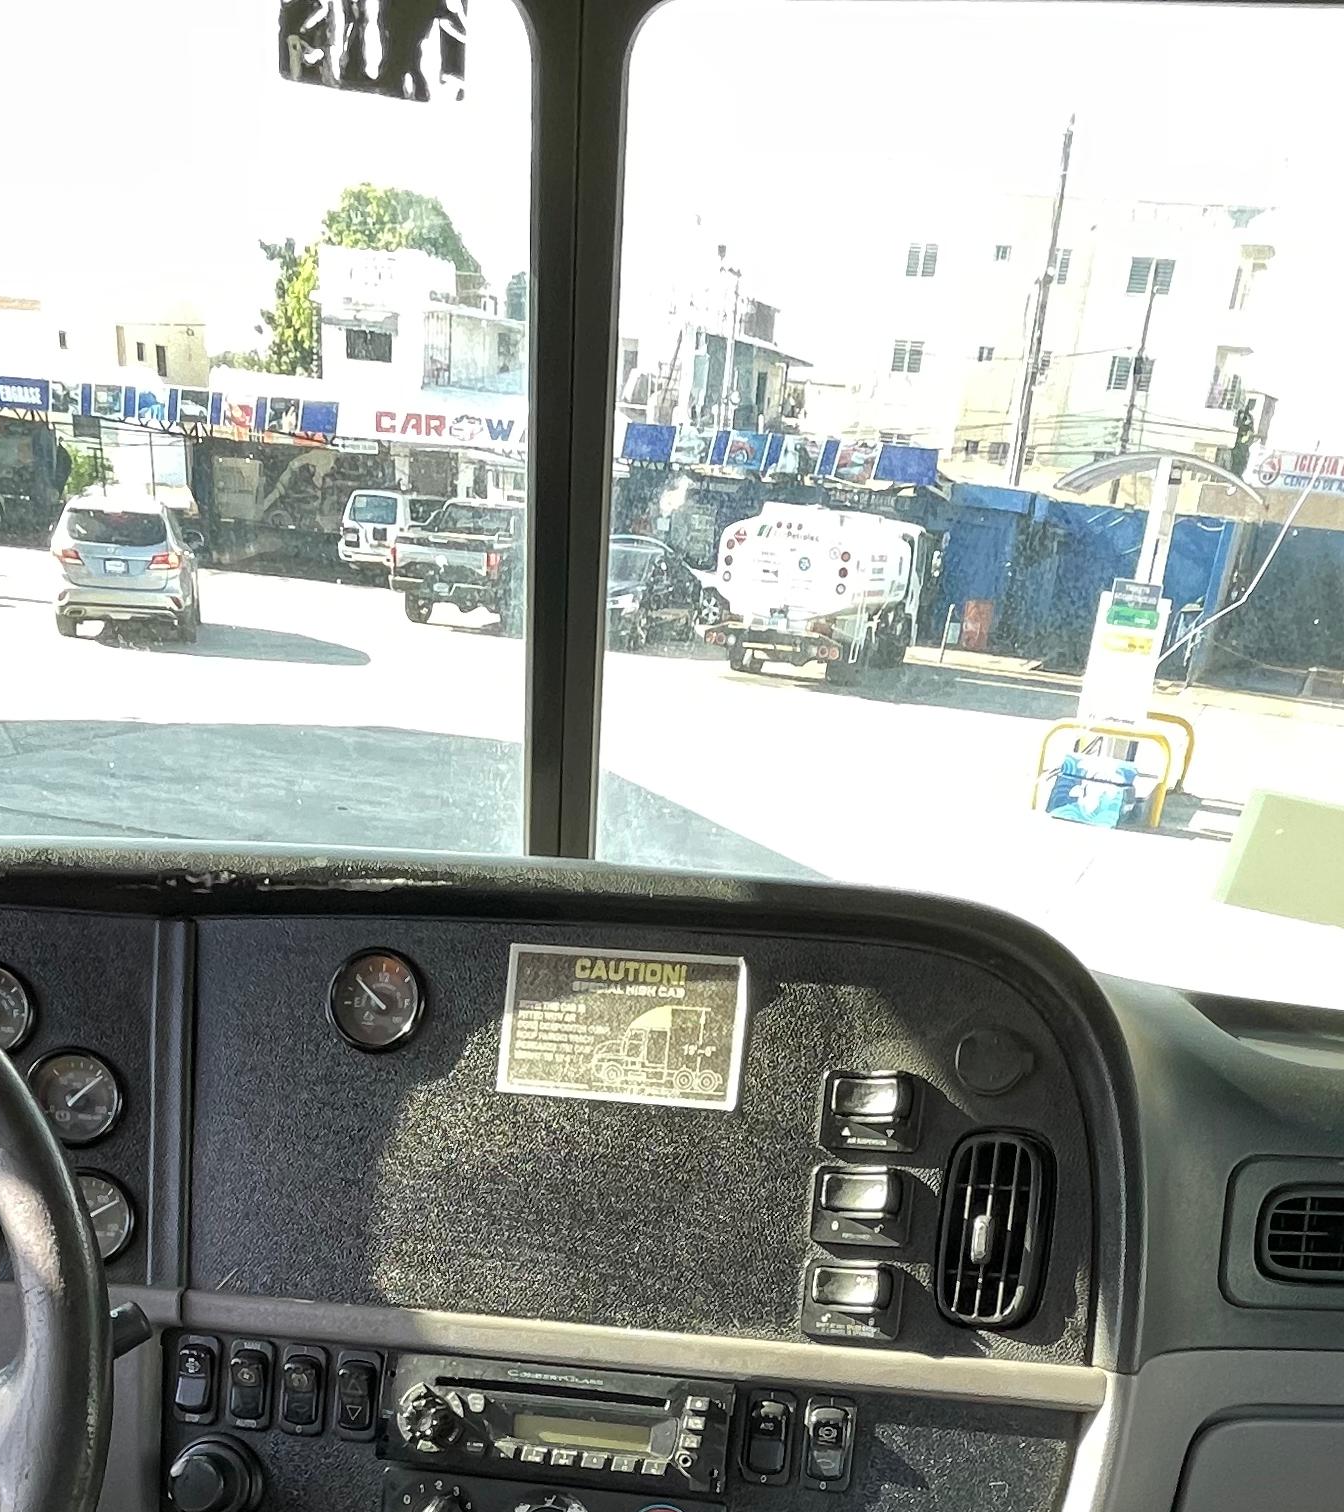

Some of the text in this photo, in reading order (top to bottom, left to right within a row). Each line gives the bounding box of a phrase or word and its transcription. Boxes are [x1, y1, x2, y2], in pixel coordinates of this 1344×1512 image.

[375, 411, 446, 437] CAR
[1294, 454, 1340, 477] IGLESIA
[575, 958, 688, 986] CAUTION!
[434, 1479, 444, 1491] 2
